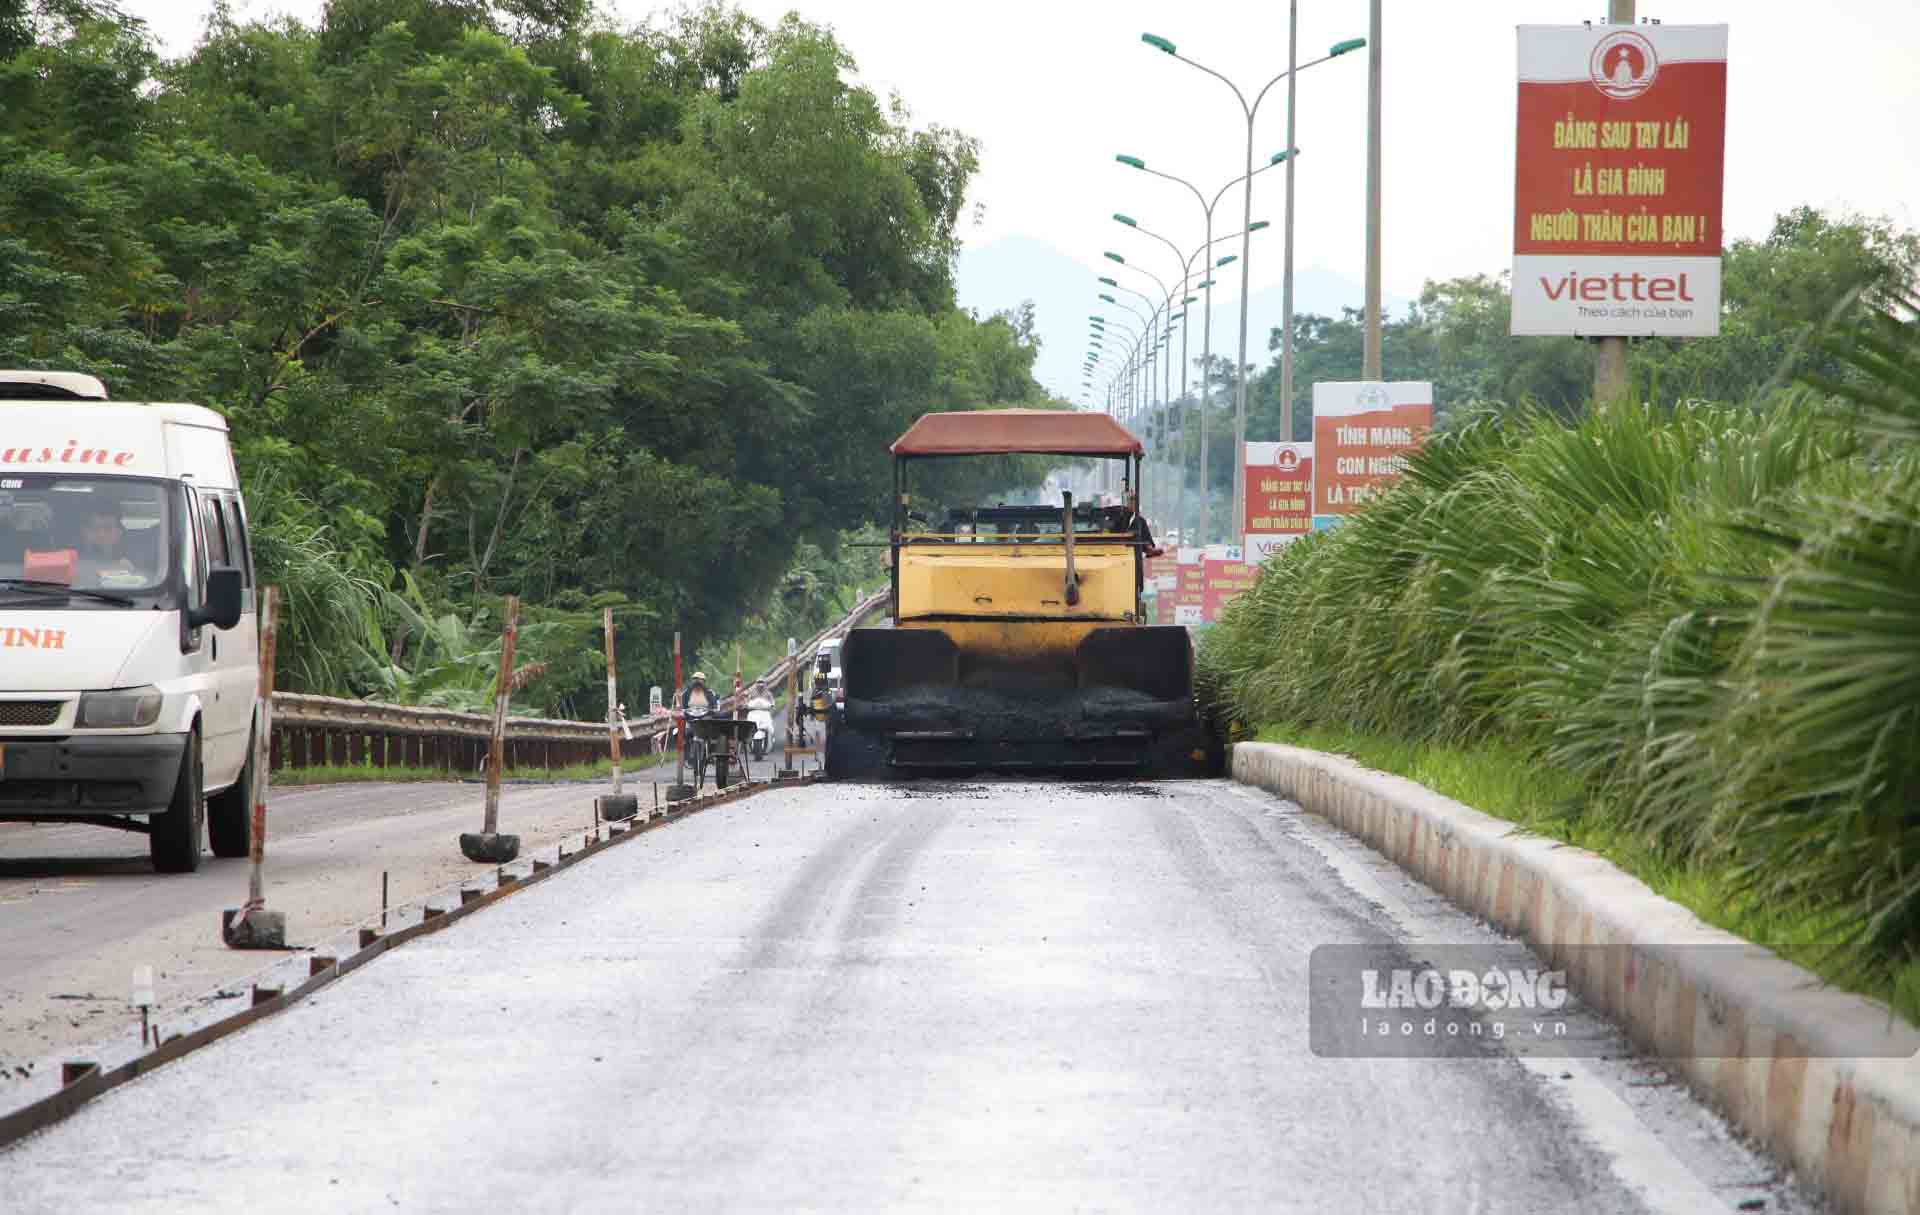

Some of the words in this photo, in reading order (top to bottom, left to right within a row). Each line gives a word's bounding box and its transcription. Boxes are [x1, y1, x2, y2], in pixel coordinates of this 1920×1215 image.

[1600, 121, 1632, 149] SAU
[1635, 121, 1661, 149] TAY
[1664, 116, 1689, 149] LÁI
[1573, 162, 1593, 195] LÀ
[1598, 168, 1624, 195] GIA
[1627, 162, 1665, 195] ĐÌNH
[1531, 208, 1579, 241] NGƯỜI
[1583, 209, 1624, 242] THÂN
[1627, 205, 1658, 242] CỦA
[1662, 215, 1697, 248] BẠN
[1540, 271, 1694, 302] viettel
[1336, 424, 1367, 446] TÍNH
[1336, 456, 1365, 475] CON
[1328, 484, 1344, 505] LÀ
